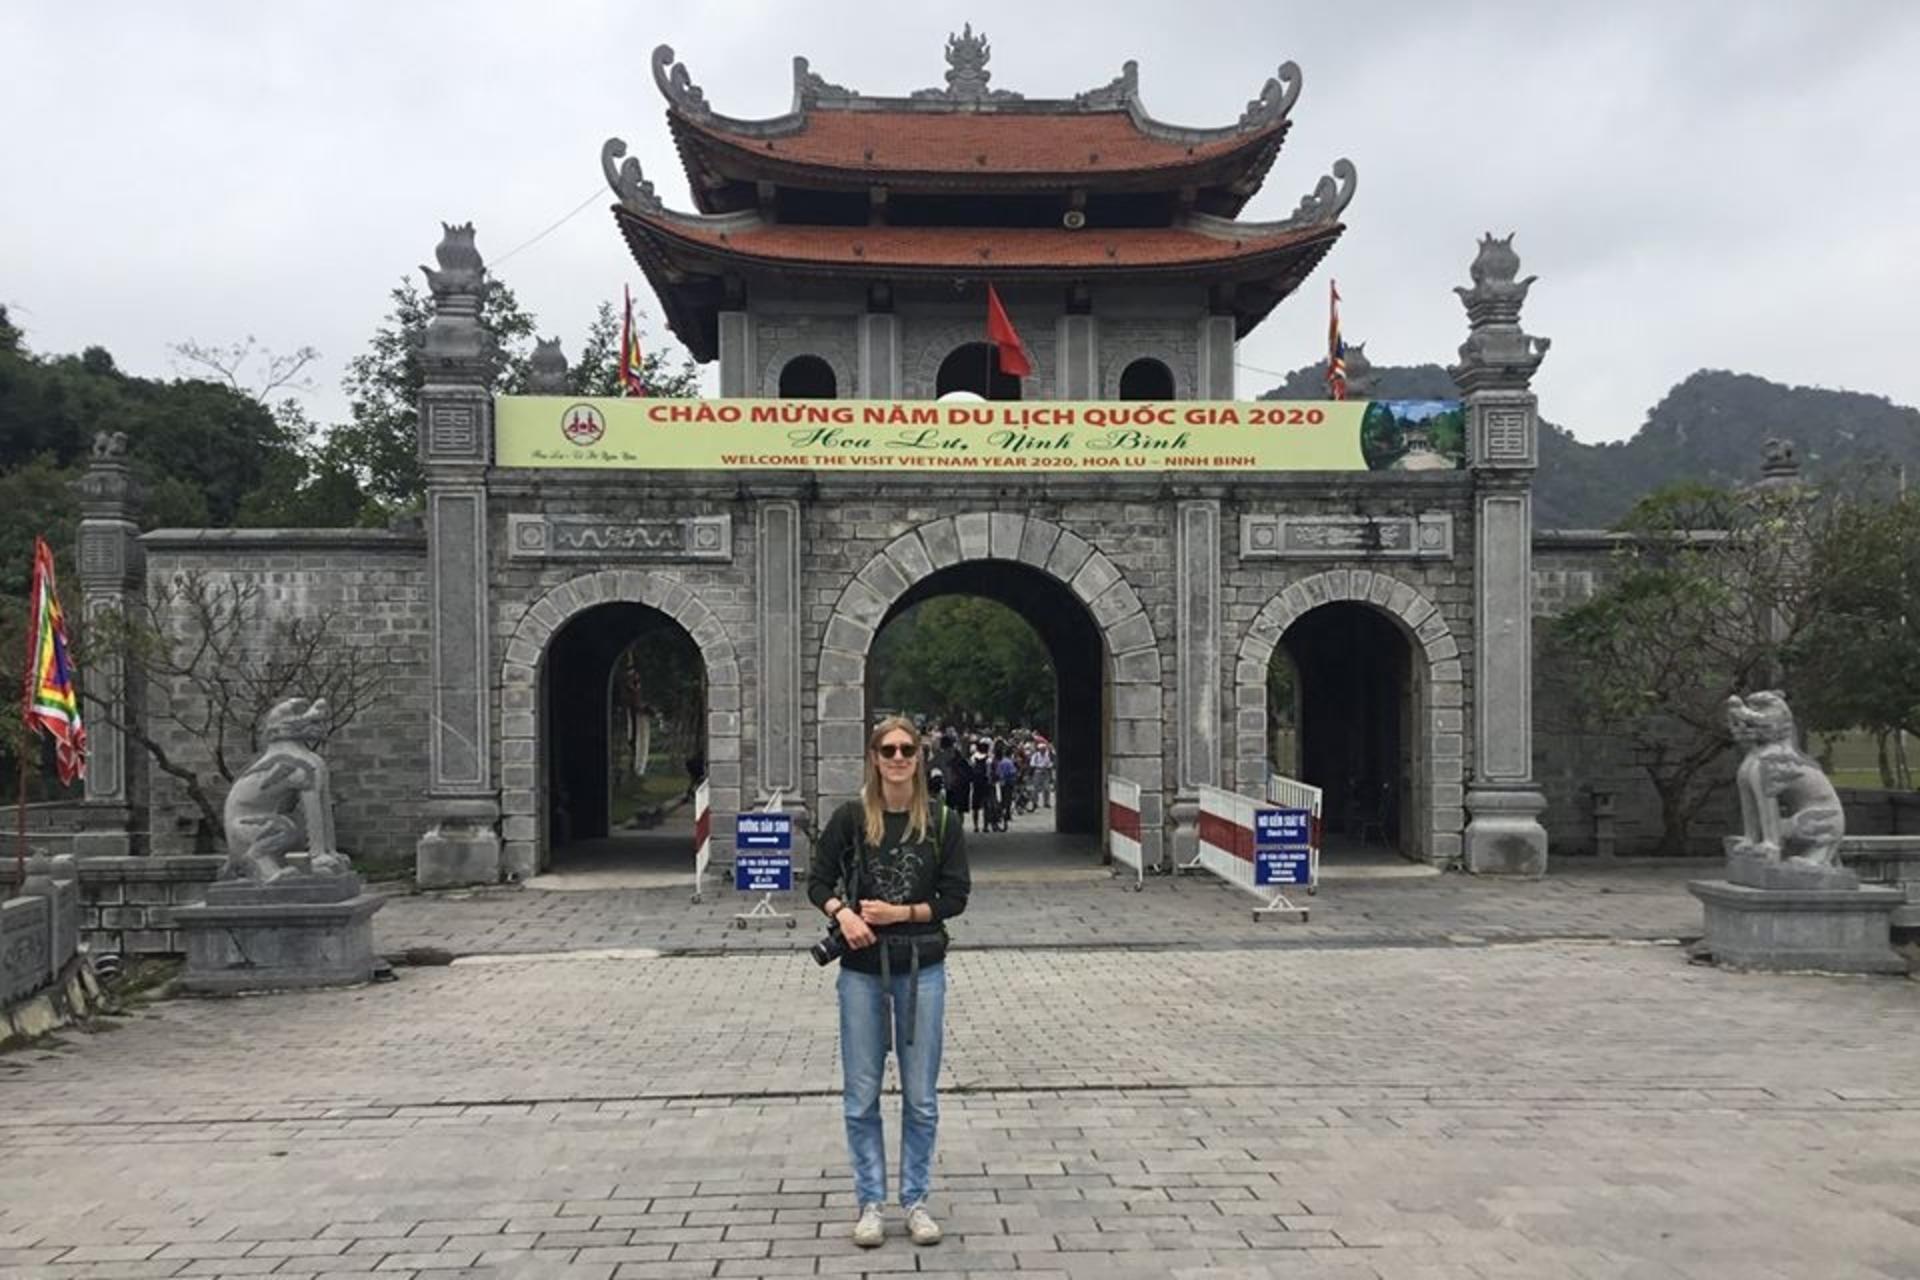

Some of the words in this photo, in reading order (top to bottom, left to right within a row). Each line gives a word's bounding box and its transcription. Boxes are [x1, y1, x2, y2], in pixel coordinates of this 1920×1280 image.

[648, 403, 742, 423] CHÀO
[751, 402, 855, 424] MỪNG
[863, 403, 939, 424] NĂM
[949, 409, 994, 425] DU
[1003, 409, 1075, 430] LỊCH
[1083, 404, 1176, 427] QUỐC
[1184, 409, 1240, 425] GIA
[1248, 409, 1325, 425] 2020
[787, 426, 872, 449] Hoa
[987, 429, 1075, 453] Ninh
[721, 454, 809, 466] WELCOME
[814, 455, 847, 466] THE
[850, 455, 893, 466] VISIT
[899, 456, 978, 467] VIETNAM
[982, 456, 1027, 467] YEAR
[1031, 457, 1078, 468] 2020,
[1082, 457, 1120, 468] HOA
[1165, 457, 1209, 467] NINH
[1214, 457, 1256, 467] BINH
